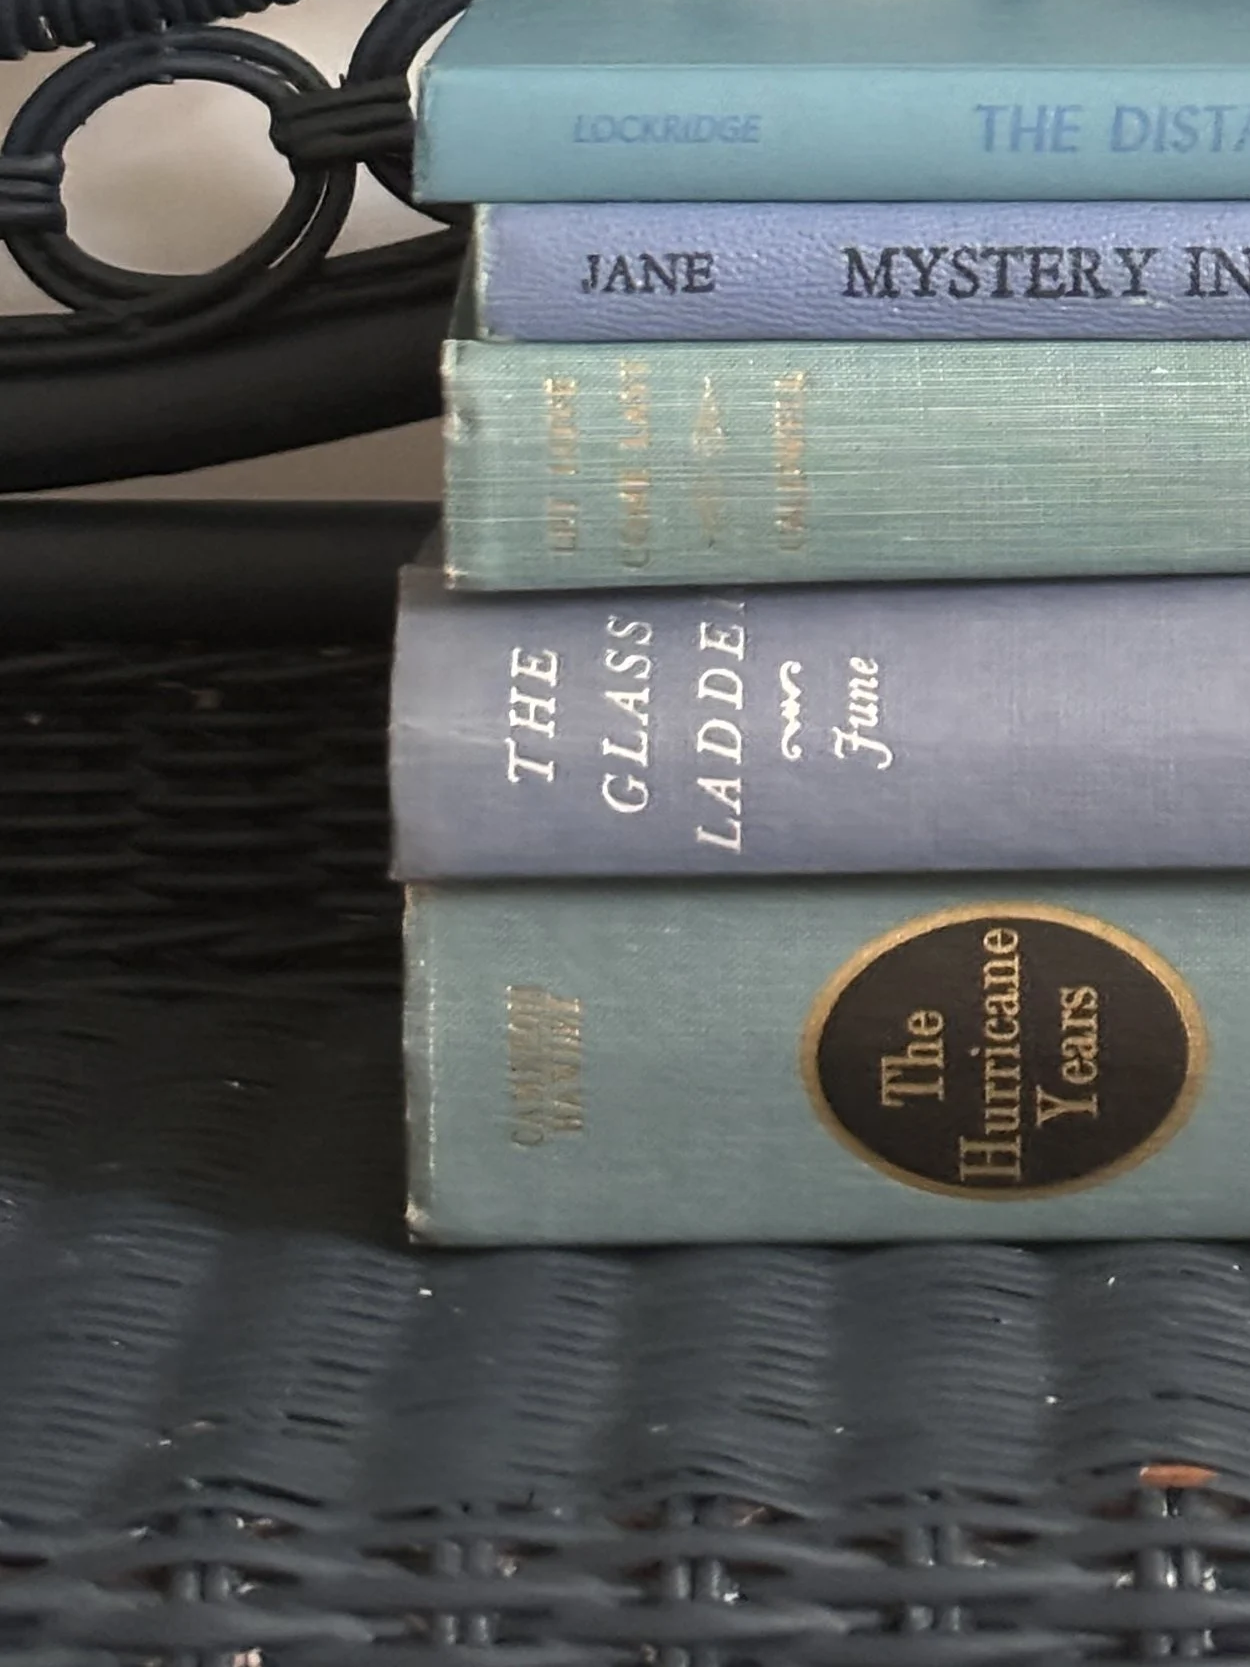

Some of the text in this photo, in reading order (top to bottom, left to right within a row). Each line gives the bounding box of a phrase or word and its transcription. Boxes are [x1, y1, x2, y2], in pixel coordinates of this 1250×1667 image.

[572, 113, 762, 144] LOCKRIDGE
[975, 104, 1084, 153] THE
[581, 251, 716, 295] JANE
[841, 245, 1162, 299] MYSTERY
[504, 645, 558, 784] THE
[600, 613, 653, 814] GLASS
[831, 656, 894, 770] June
[880, 1009, 946, 1107] The
[959, 928, 1022, 1182] Hurricane
[1036, 985, 1100, 1128] Years
